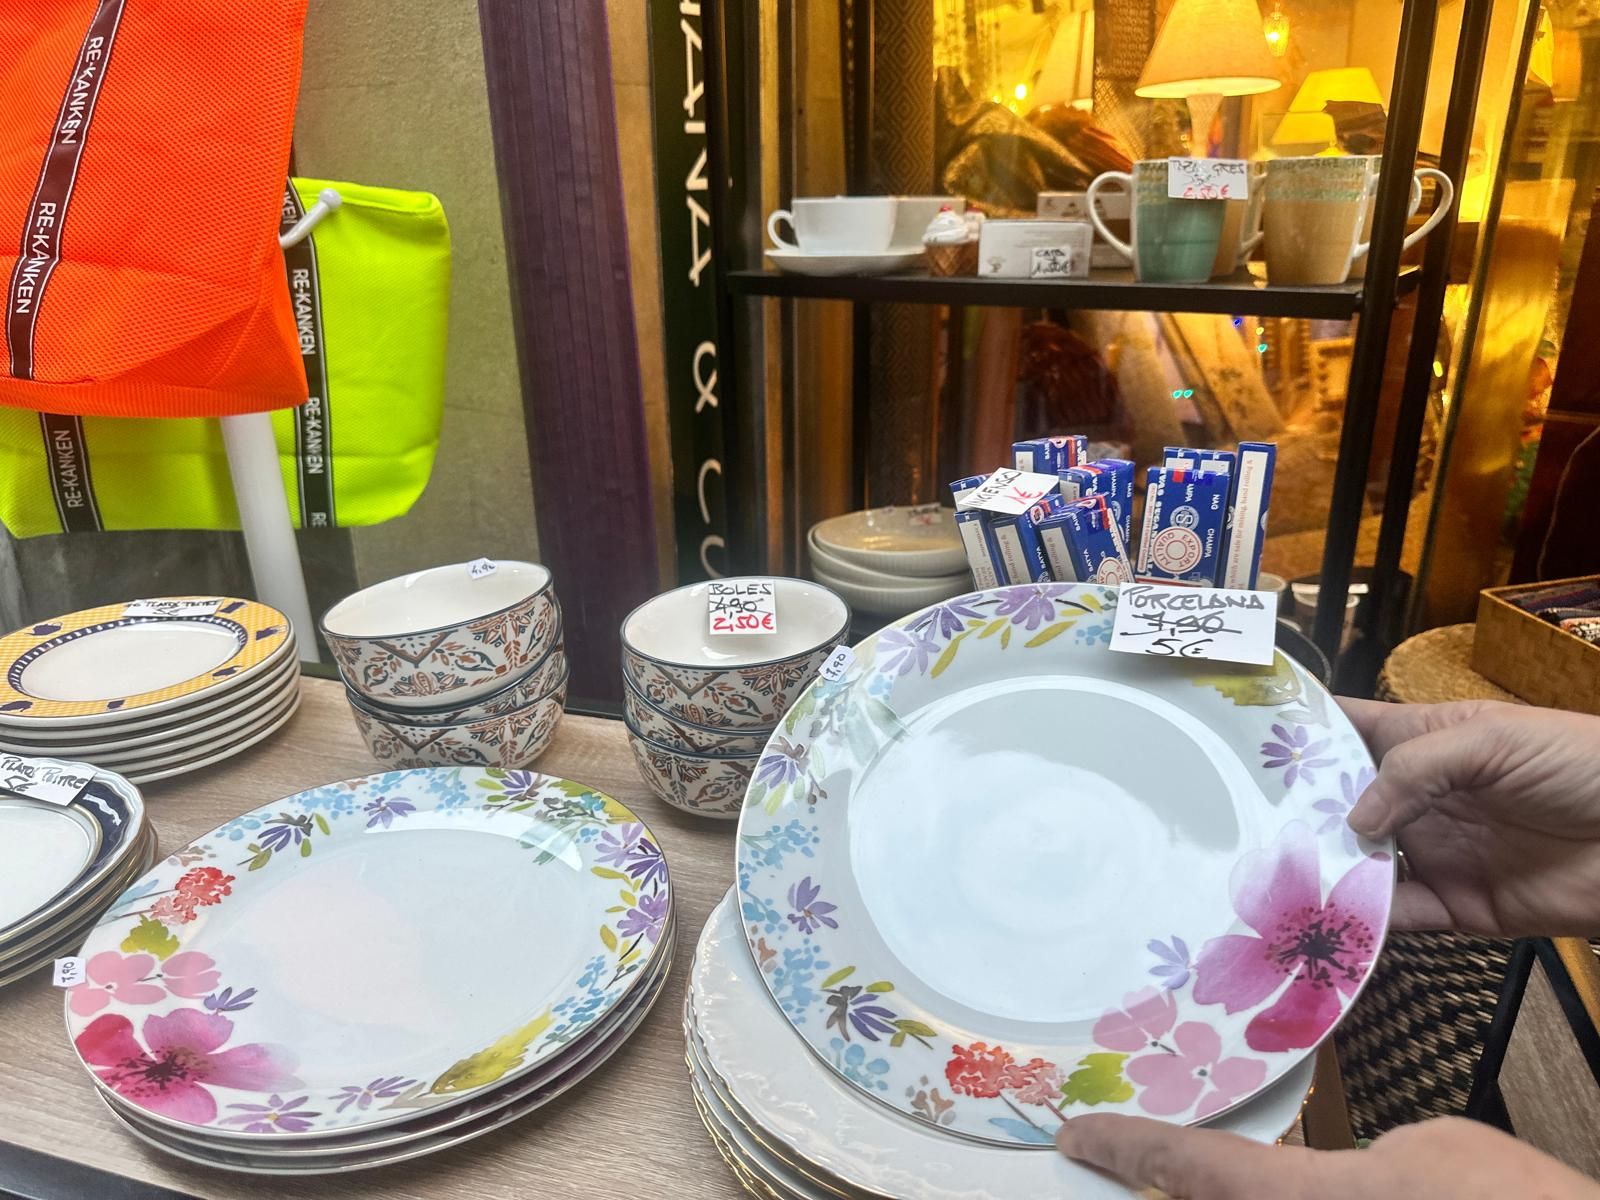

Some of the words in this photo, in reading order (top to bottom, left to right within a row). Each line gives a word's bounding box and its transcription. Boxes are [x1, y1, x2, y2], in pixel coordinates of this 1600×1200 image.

[60, 36, 104, 144] RE-KANKEN
[16, 202, 57, 314] RE-KANKEN
[292, 268, 317, 356] RE-KANKEN
[56, 430, 82, 508] RE-KANKEN
[1211, 494, 1220, 510] NAG
[1156, 532, 1175, 566] QUALITY
[1179, 534, 1196, 568] EXPORT
[1204, 528, 1215, 558] CHAMPA
[1036, 545, 1047, 569] SATYA
[1083, 548, 1094, 572] SATYA
[709, 583, 772, 595] BOLES
[1122, 586, 1265, 610] PORCELANA
[713, 613, 774, 632] 2,50€
[1145, 638, 1214, 657] 5€
